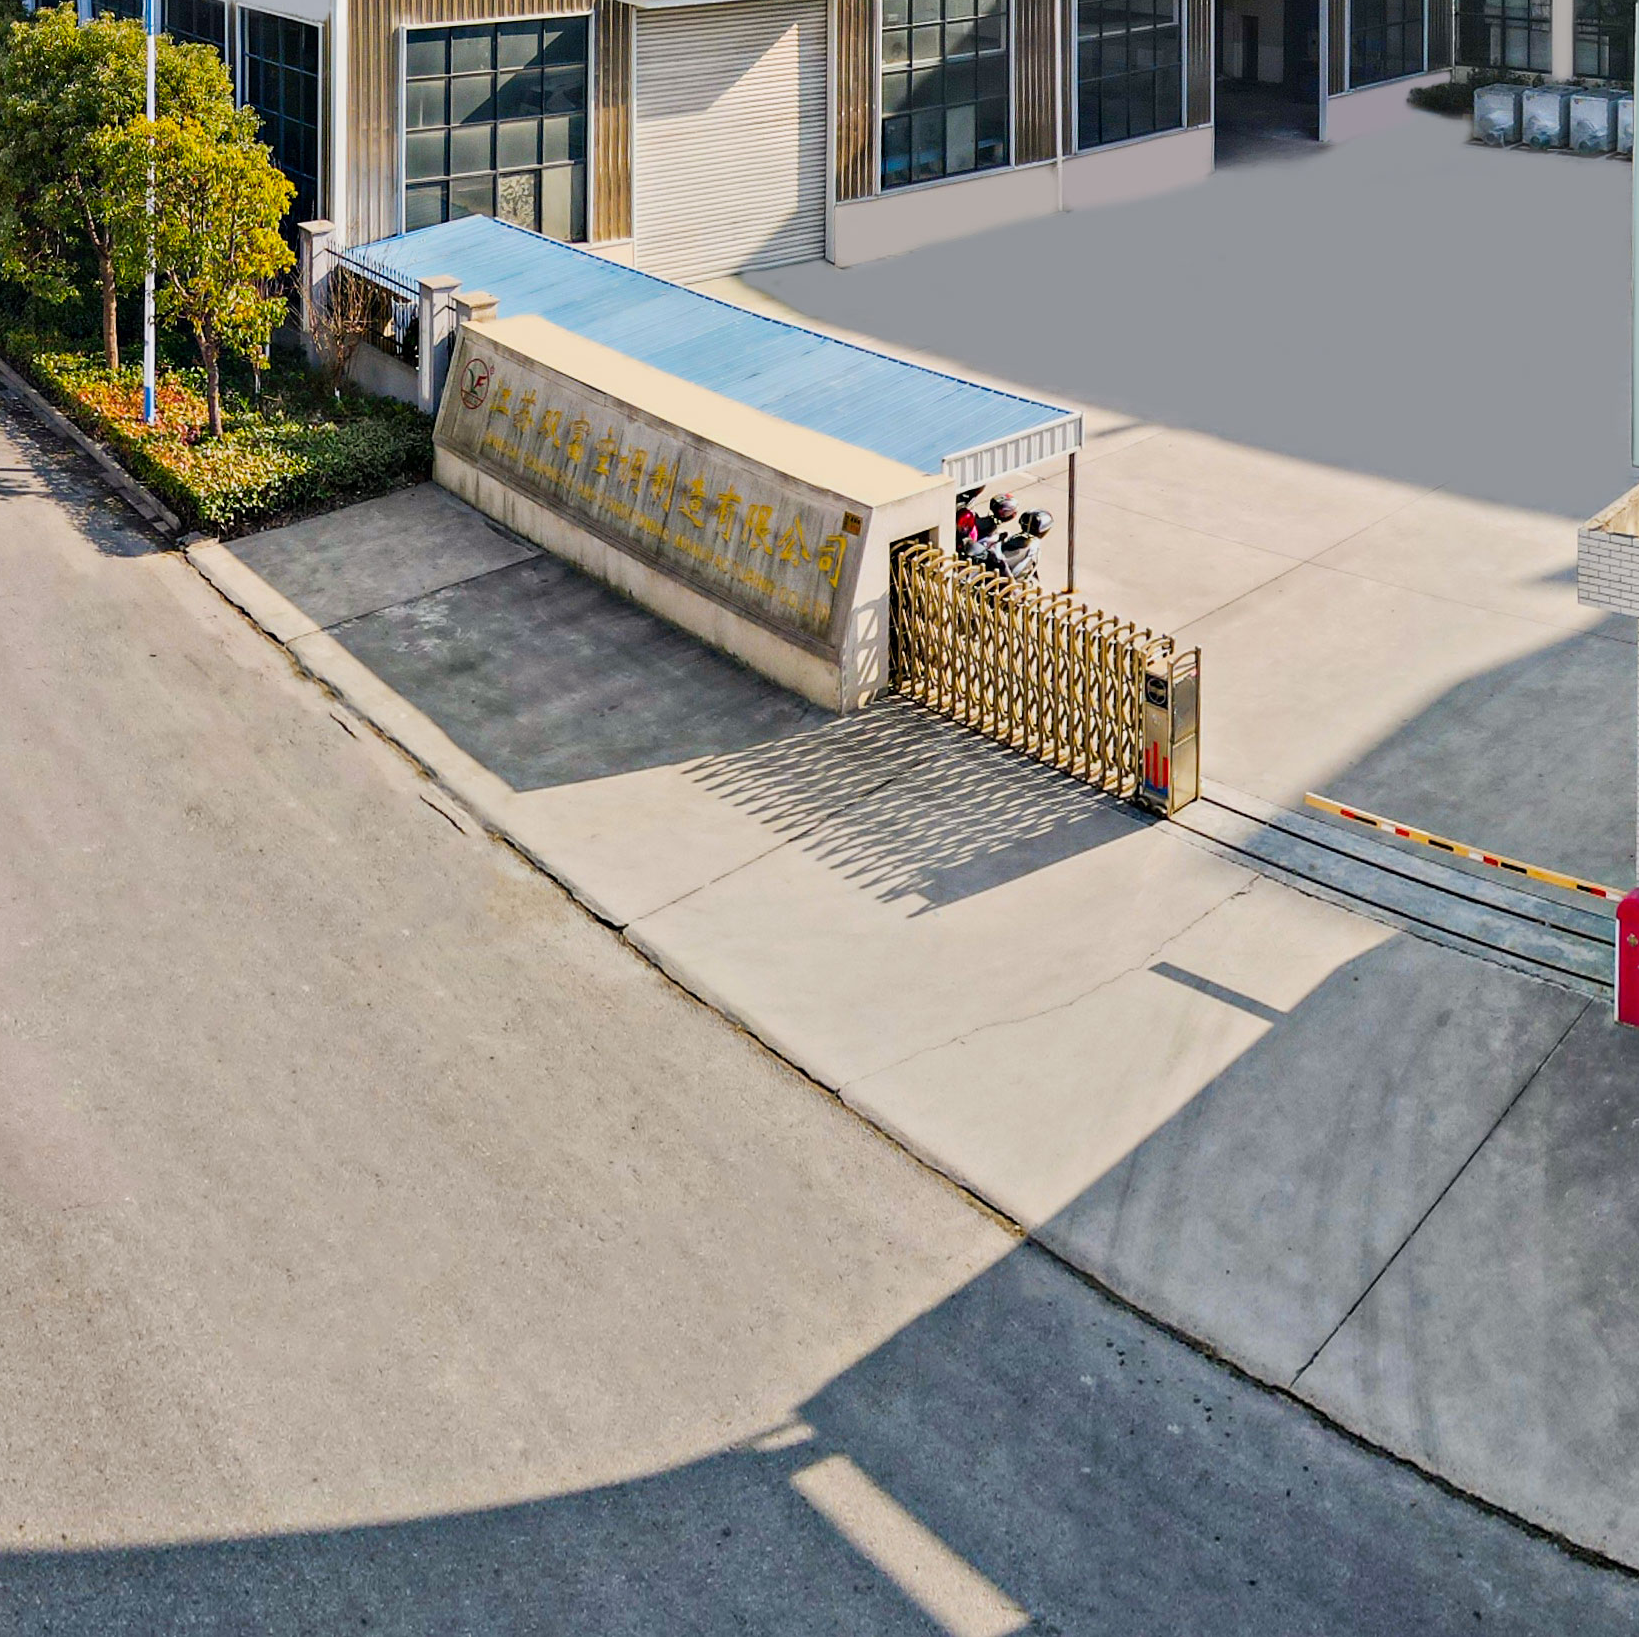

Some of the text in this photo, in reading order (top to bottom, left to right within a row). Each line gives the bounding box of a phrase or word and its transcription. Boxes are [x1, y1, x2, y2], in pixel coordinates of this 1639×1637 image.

[489, 377, 848, 589] 江苏双富空调制造有限公司
